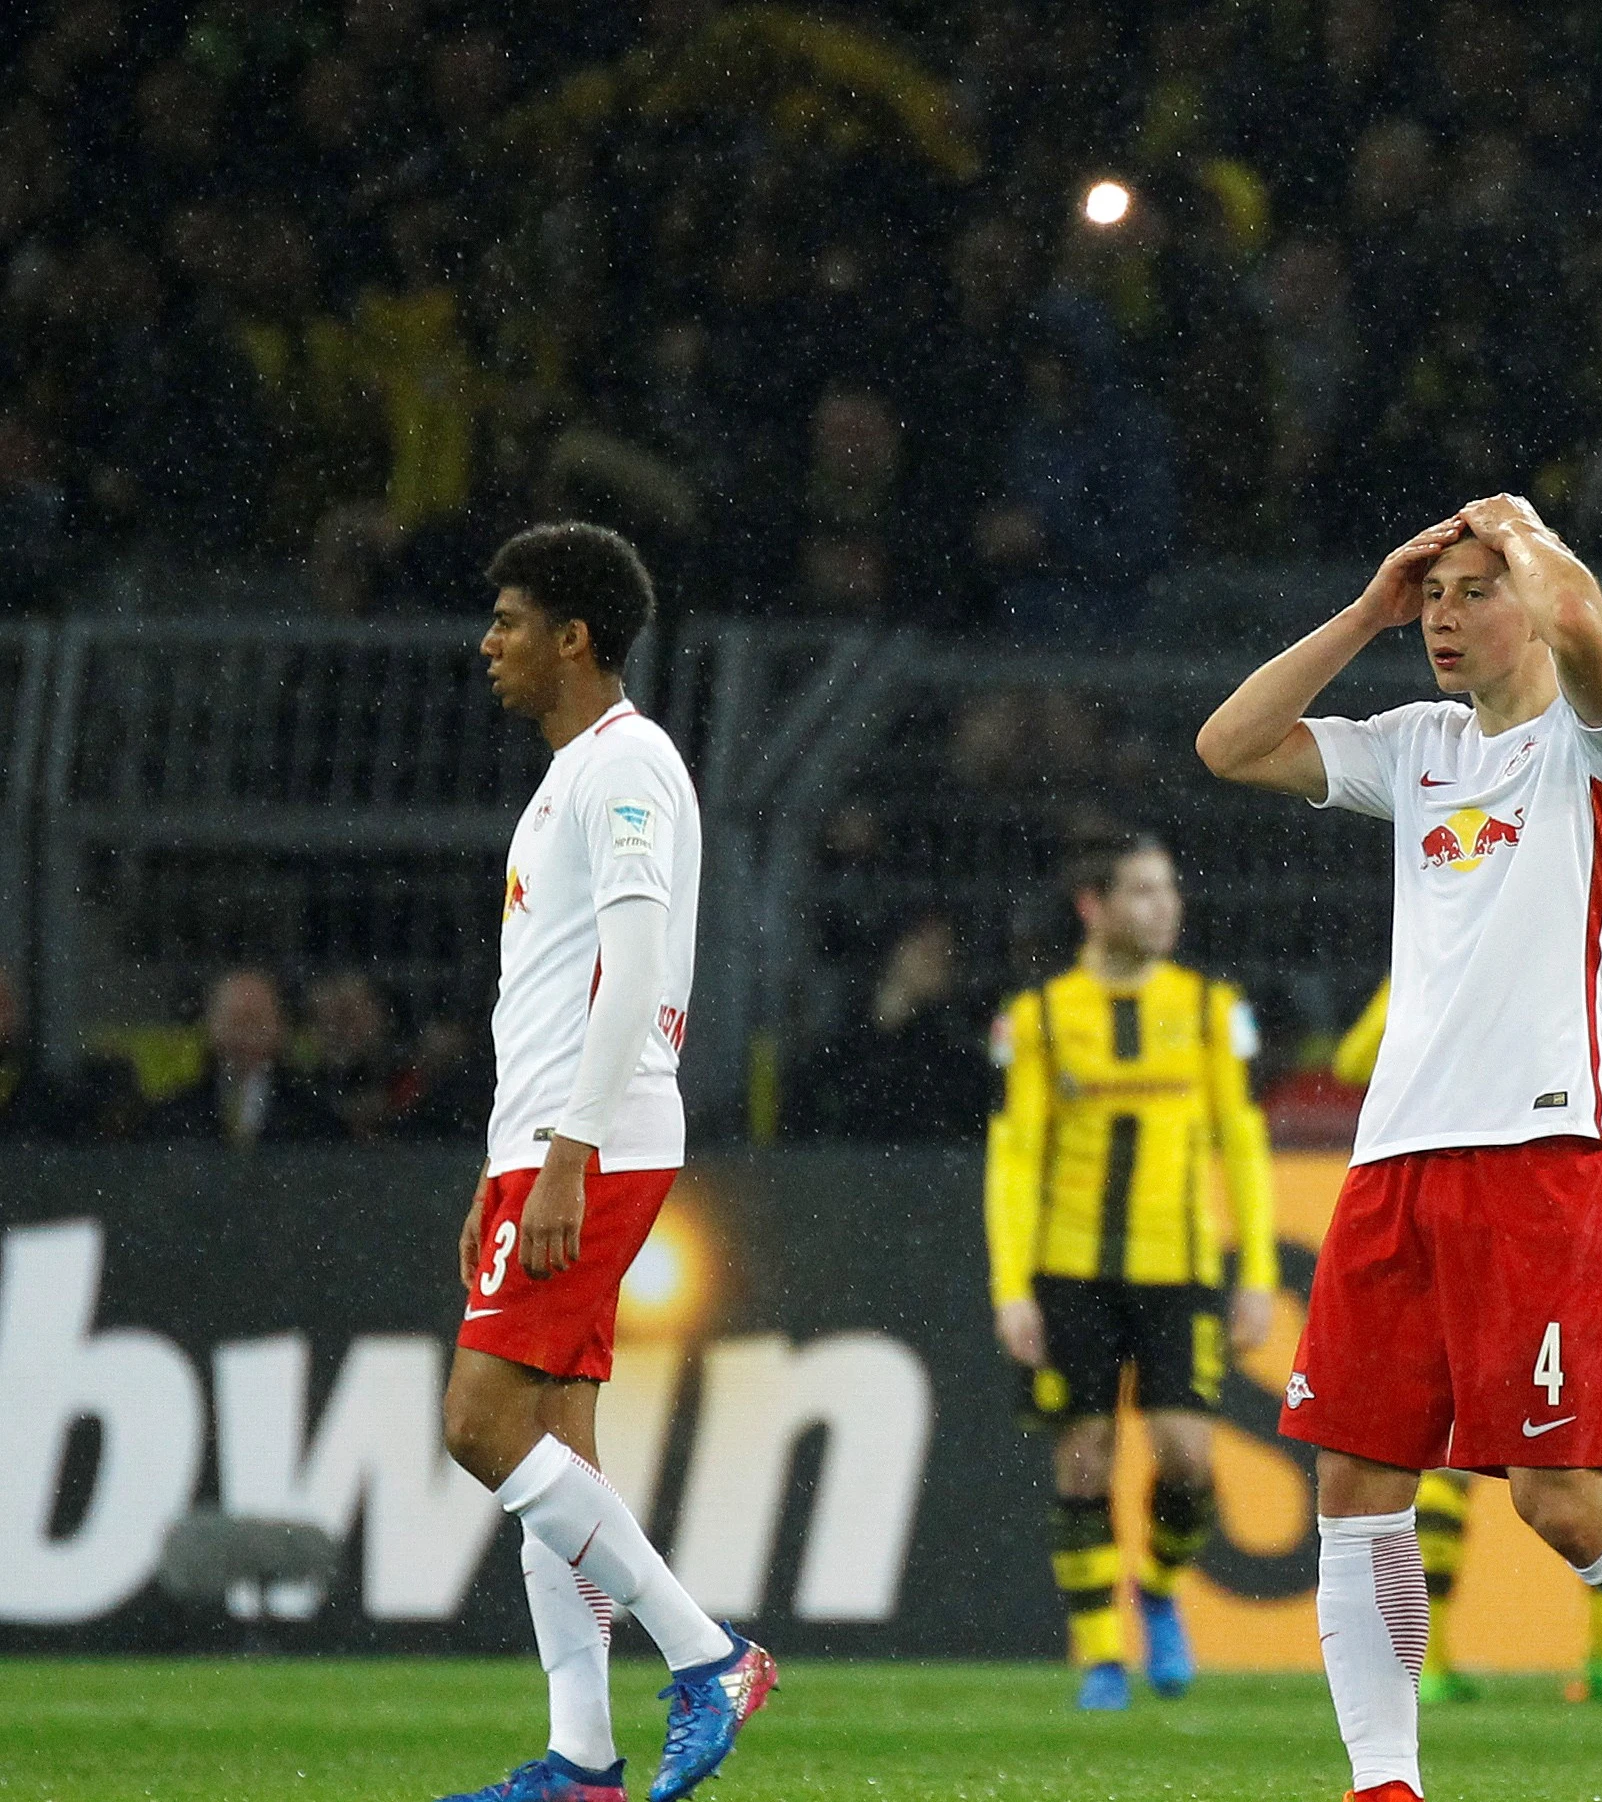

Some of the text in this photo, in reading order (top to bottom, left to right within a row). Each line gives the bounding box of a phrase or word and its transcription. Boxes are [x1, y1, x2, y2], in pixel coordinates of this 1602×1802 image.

[480, 1219, 517, 1297] 3
[1533, 1320, 1564, 1406] 4
[0, 1216, 935, 1624] bwin
